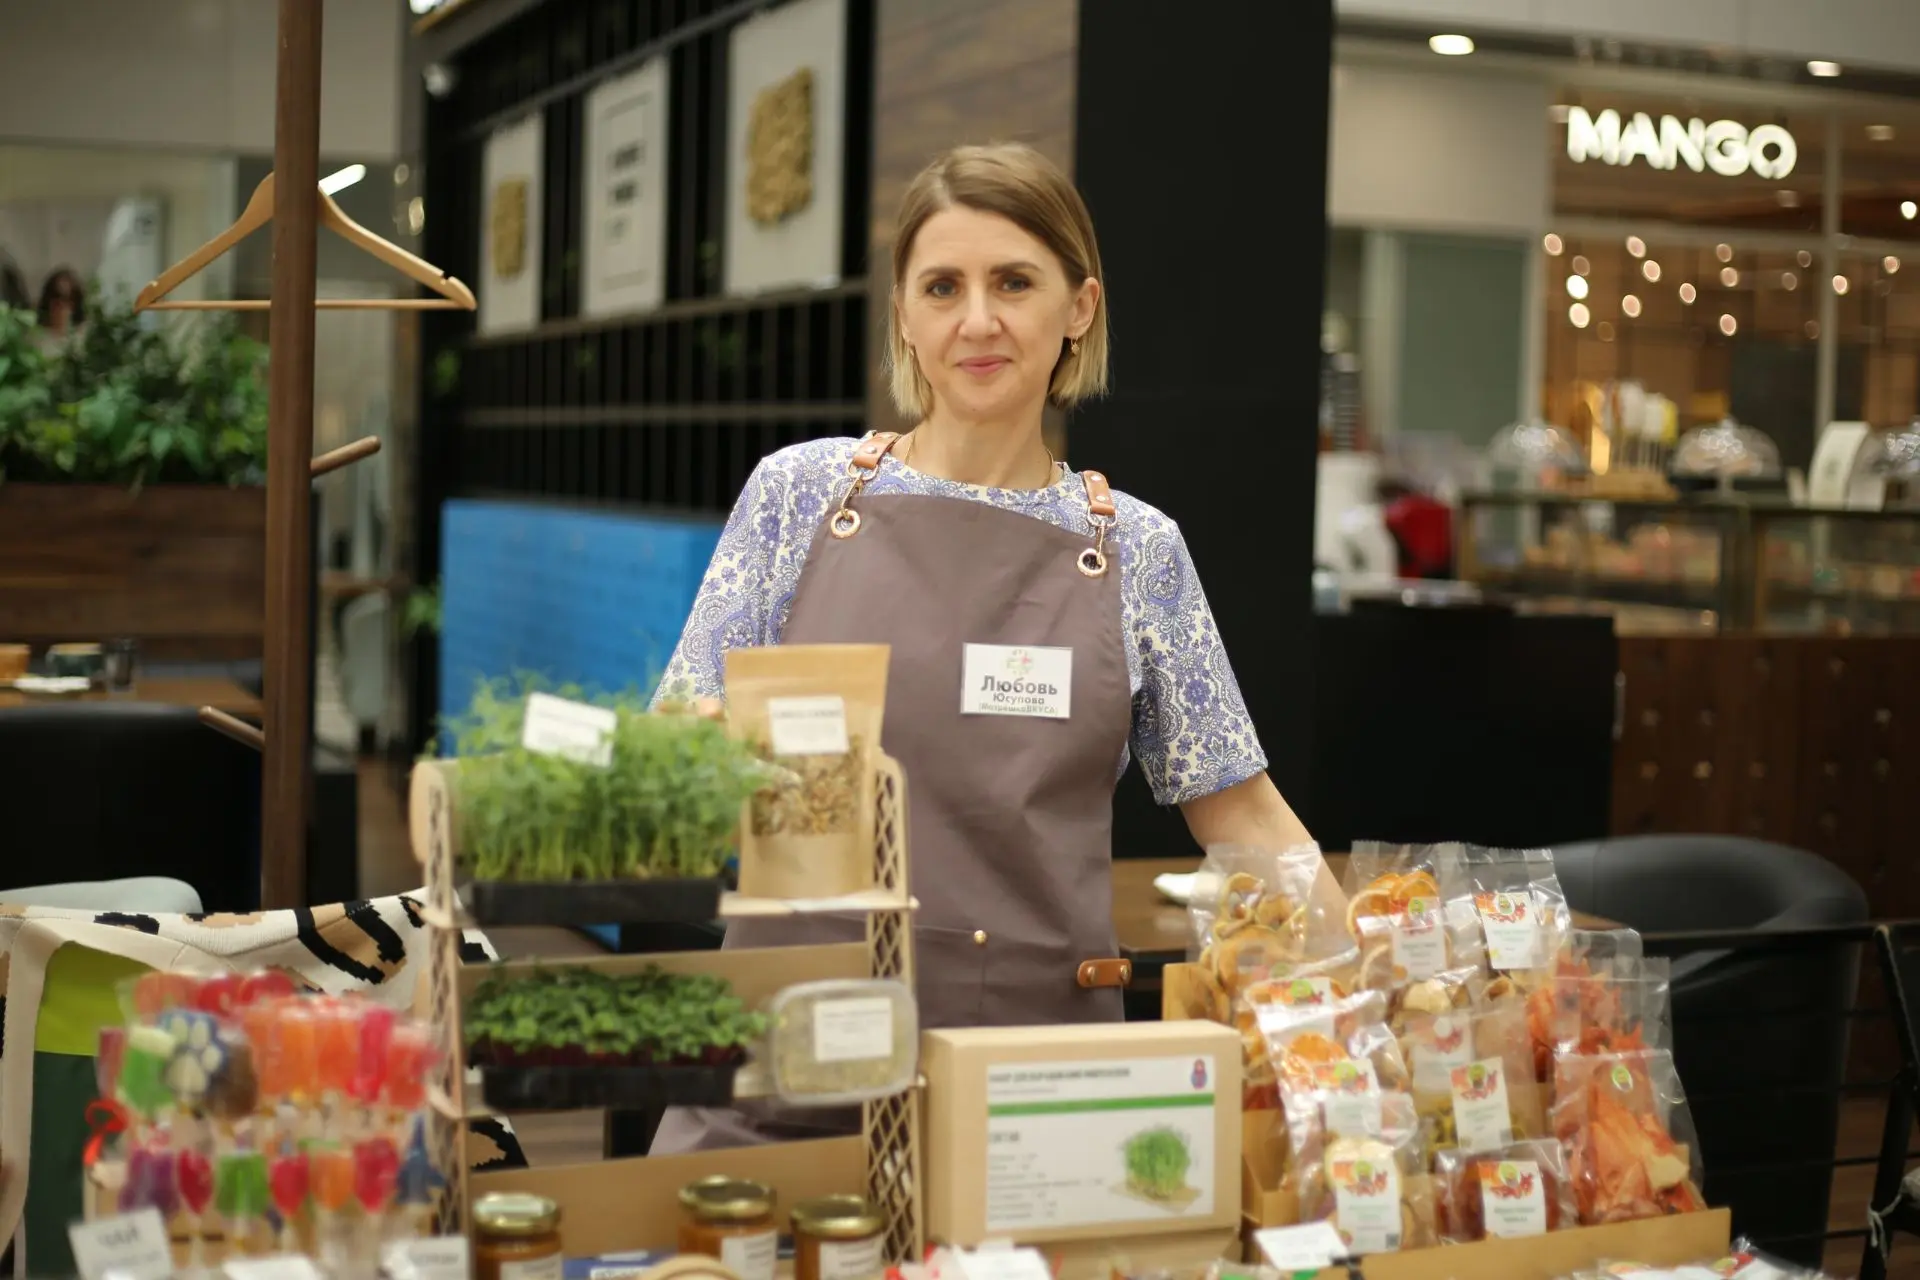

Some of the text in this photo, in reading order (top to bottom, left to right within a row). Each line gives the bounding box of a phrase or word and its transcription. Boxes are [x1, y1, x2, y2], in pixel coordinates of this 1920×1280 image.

[1567, 105, 1797, 180] MANGO
[981, 675, 1057, 695] Любовь
[993, 692, 1045, 705] Юсупова
